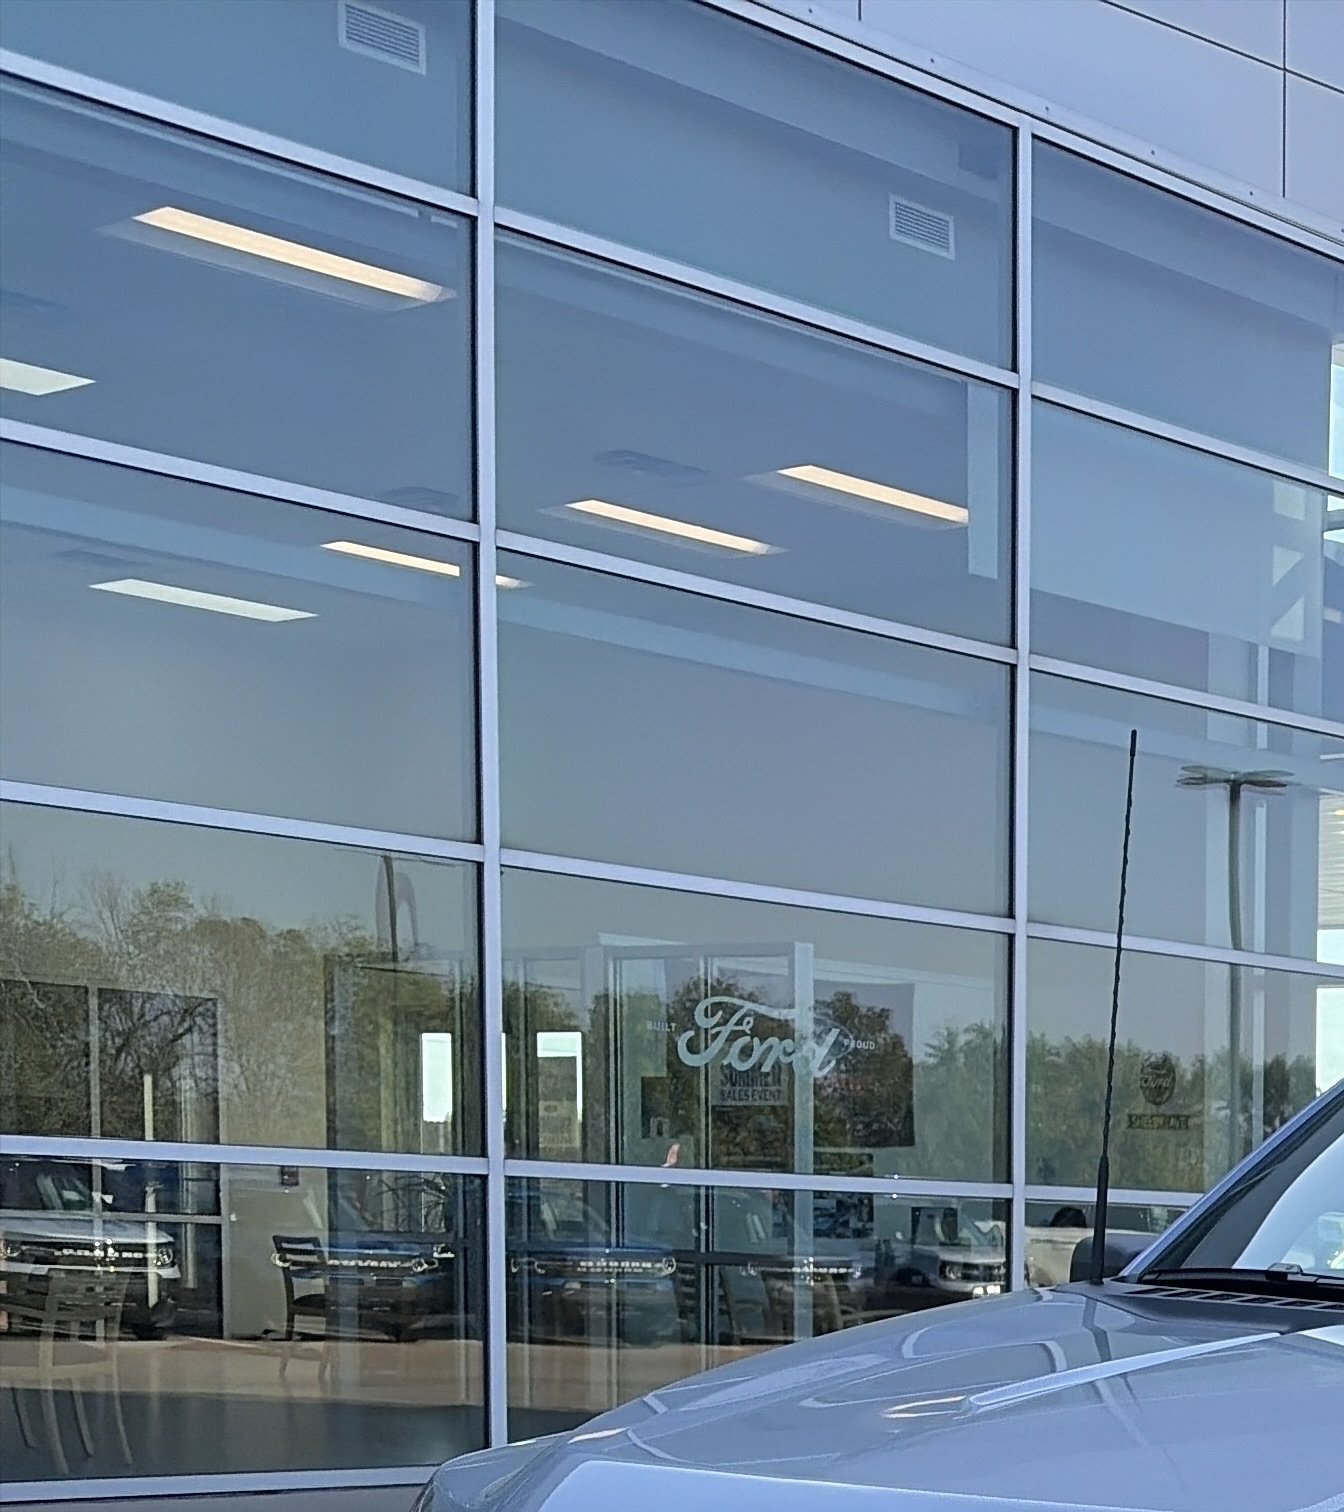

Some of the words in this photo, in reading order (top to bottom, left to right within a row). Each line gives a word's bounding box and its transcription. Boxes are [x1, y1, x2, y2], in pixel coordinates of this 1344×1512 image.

[647, 1021, 677, 1033] BUILT
[677, 996, 841, 1078] Ford
[843, 1039, 876, 1050] PROUD
[1139, 1069, 1172, 1089] Ford
[720, 1089, 750, 1100] SALES
[751, 1089, 782, 1100] EVENT
